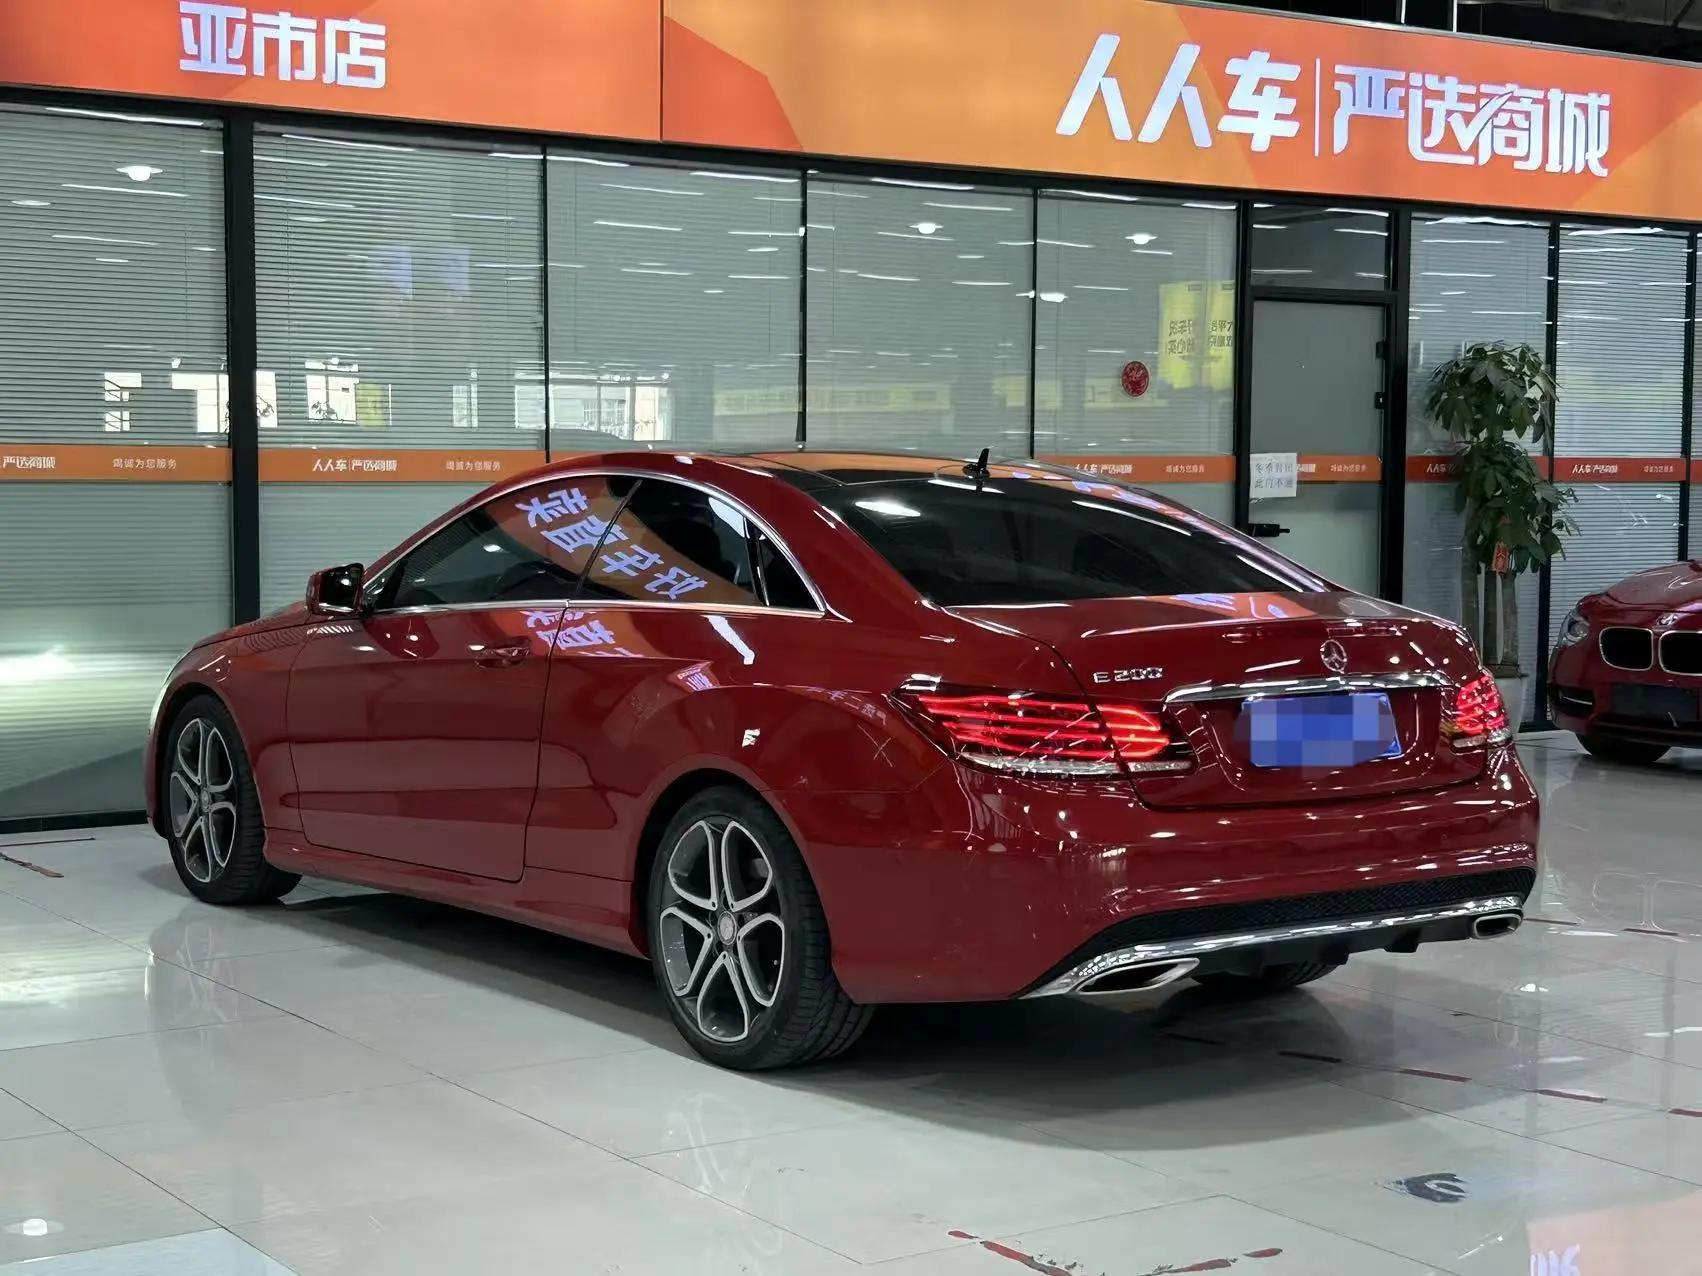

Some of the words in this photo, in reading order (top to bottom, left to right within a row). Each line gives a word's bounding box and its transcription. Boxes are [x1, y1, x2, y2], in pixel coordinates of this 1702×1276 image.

[179, 1, 386, 89] 亚市店
[1055, 33, 1300, 152] 人人车
[1333, 64, 1611, 177] 严选商城
[312, 459, 348, 472] 人人车
[1092, 671, 1111, 684] E
[1113, 666, 1163, 682] 200
